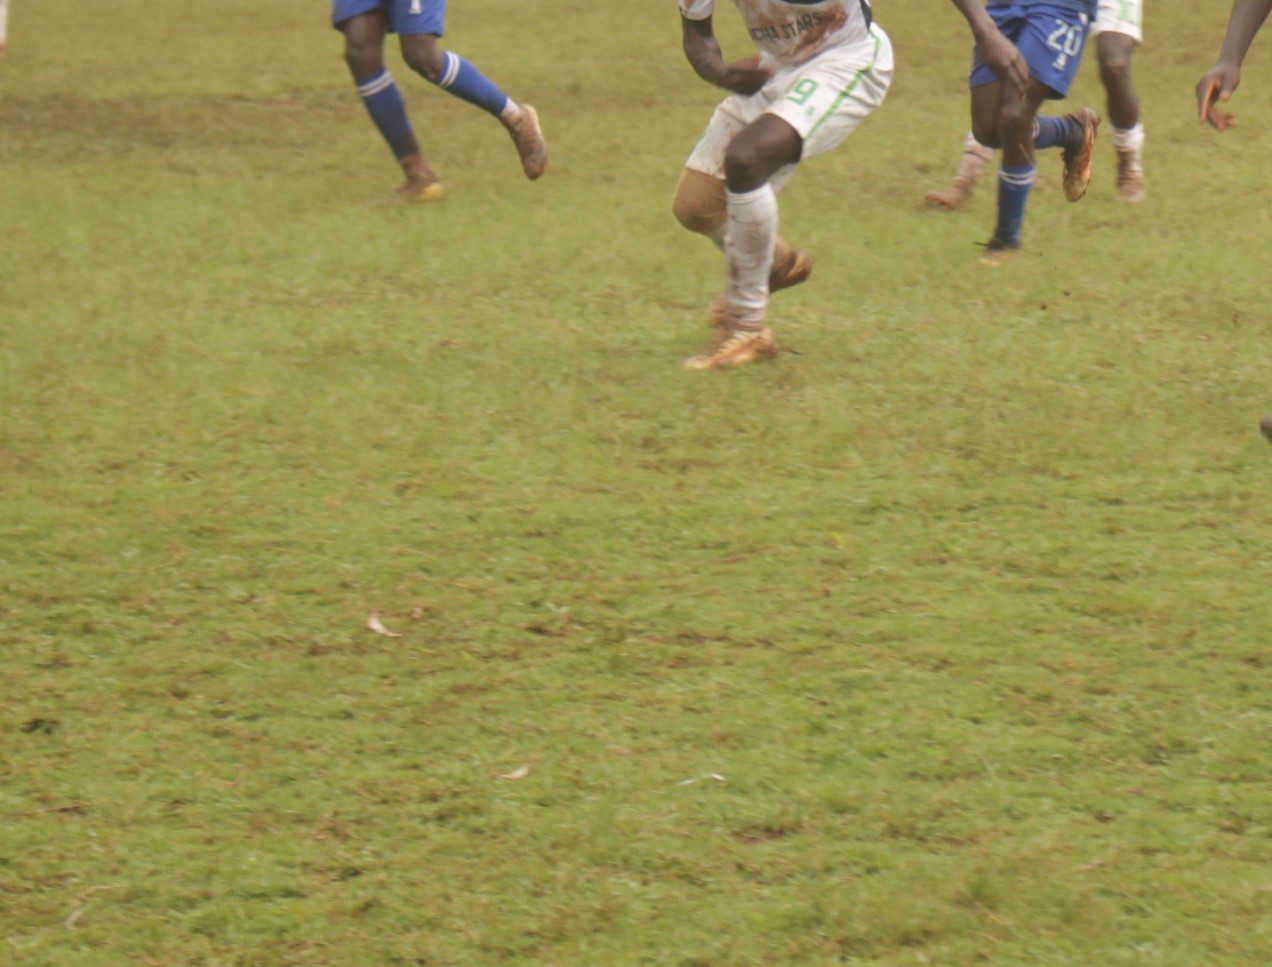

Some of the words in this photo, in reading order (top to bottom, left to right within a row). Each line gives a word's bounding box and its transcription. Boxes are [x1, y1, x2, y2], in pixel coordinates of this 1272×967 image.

[780, 13, 823, 40] STARS
[1046, 18, 1083, 57] 20
[785, 77, 819, 105] 9
